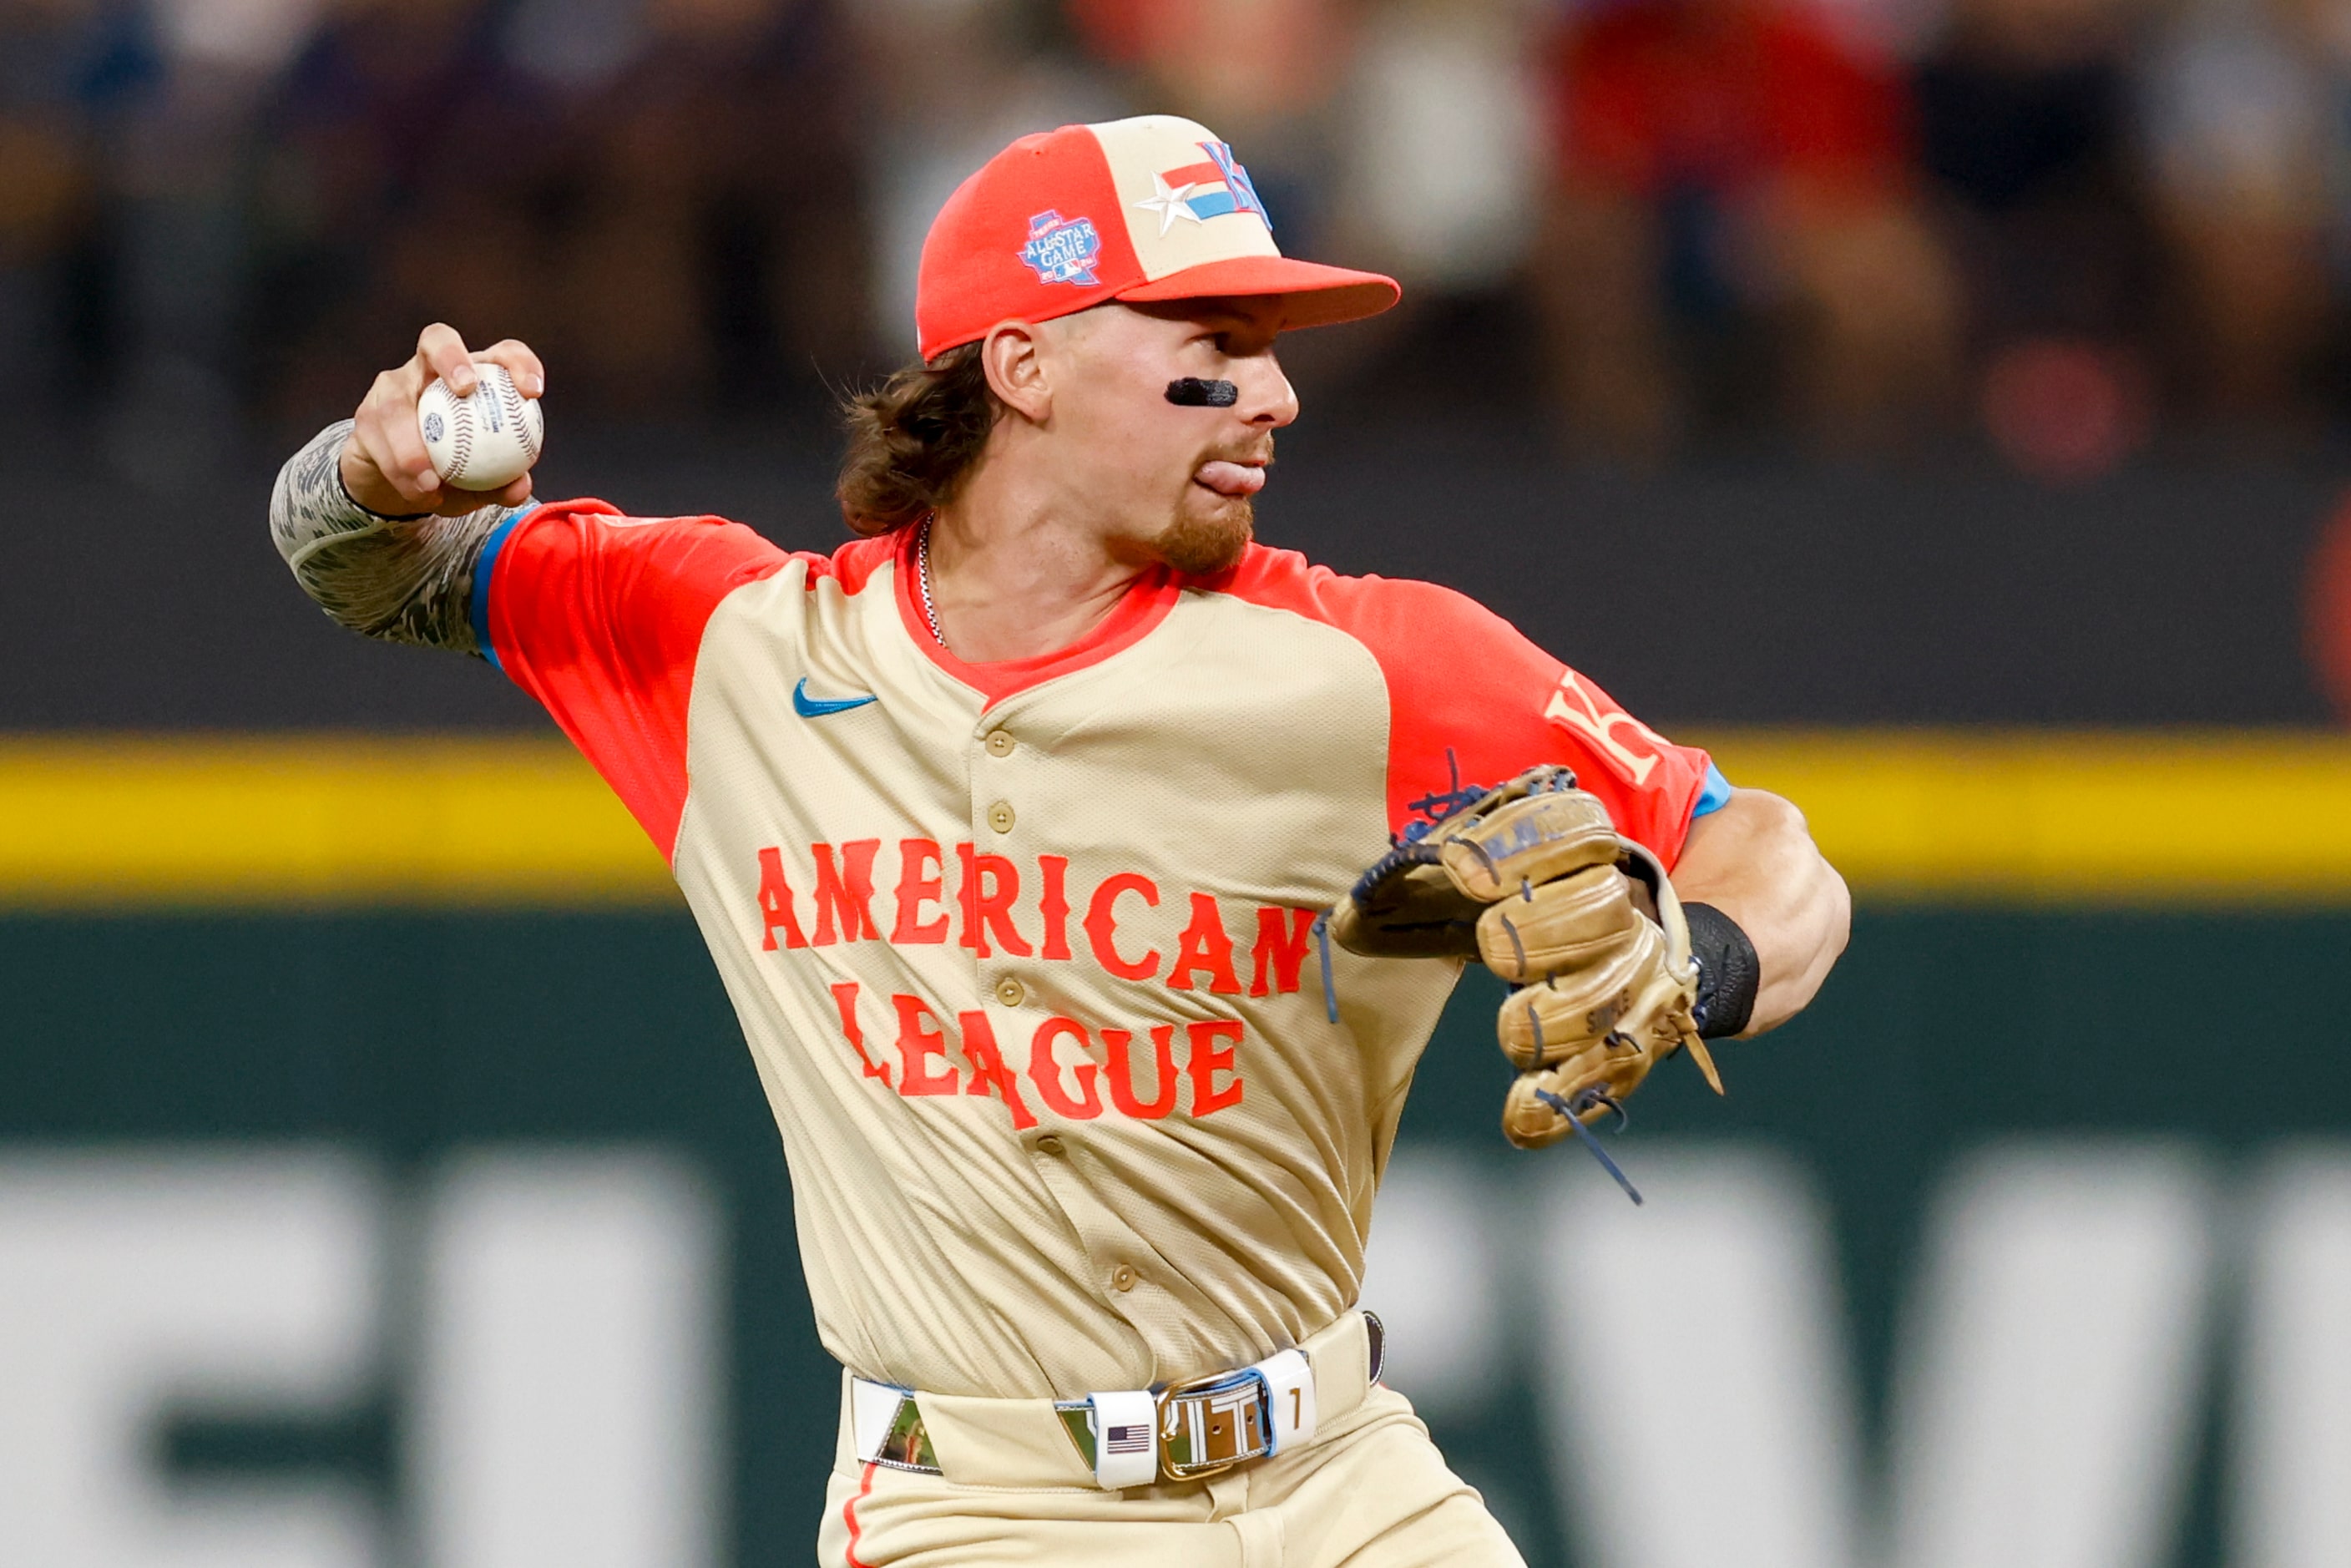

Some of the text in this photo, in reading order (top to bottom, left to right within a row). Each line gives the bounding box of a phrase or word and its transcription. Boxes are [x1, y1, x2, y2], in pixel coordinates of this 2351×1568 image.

[1040, 240, 1086, 266] GAME
[757, 837, 1317, 997] AMERICAN
[831, 982, 1244, 1130] LEAGUE
